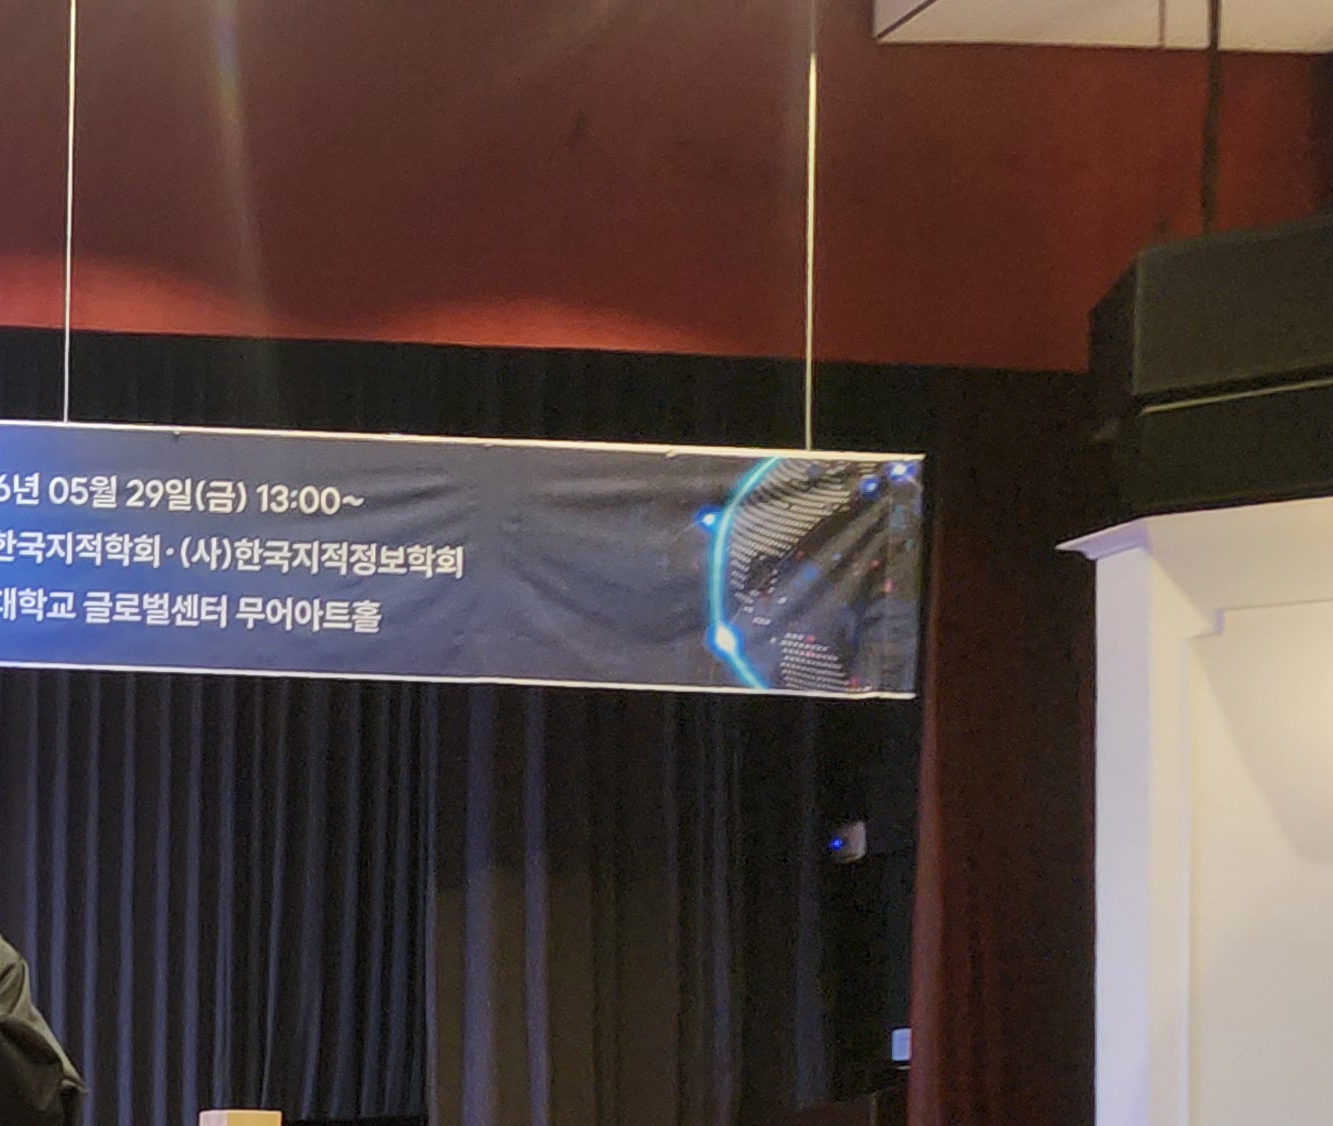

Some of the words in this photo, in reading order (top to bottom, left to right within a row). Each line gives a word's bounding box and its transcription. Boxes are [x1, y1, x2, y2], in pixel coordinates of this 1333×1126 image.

[48, 475, 117, 508] 05월
[125, 478, 247, 514] 29일(금)
[257, 483, 365, 515] 13:00~
[83, 591, 228, 629] 글로벌센터
[235, 597, 383, 634] 무어아트홀
